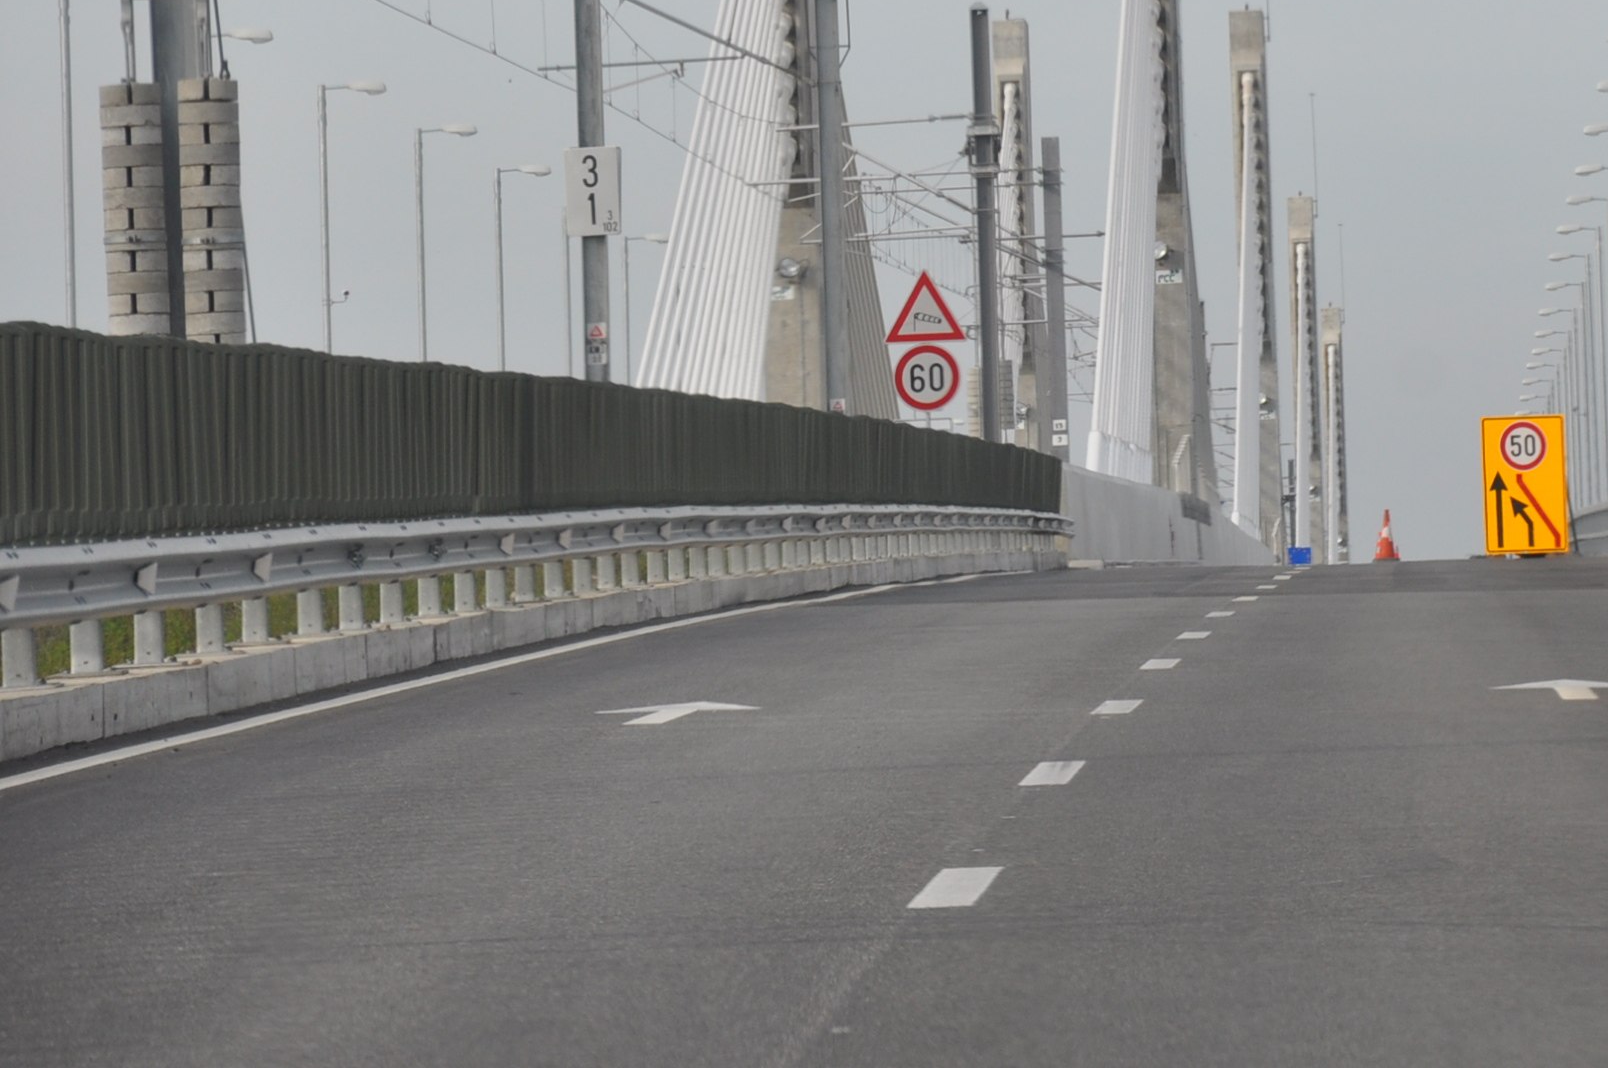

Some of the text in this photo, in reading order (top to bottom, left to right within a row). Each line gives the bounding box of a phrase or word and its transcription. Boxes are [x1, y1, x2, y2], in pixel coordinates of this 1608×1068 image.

[582, 154, 598, 188] 3
[587, 193, 597, 225] 1
[910, 363, 944, 393] 60
[1510, 434, 1536, 457] 50
